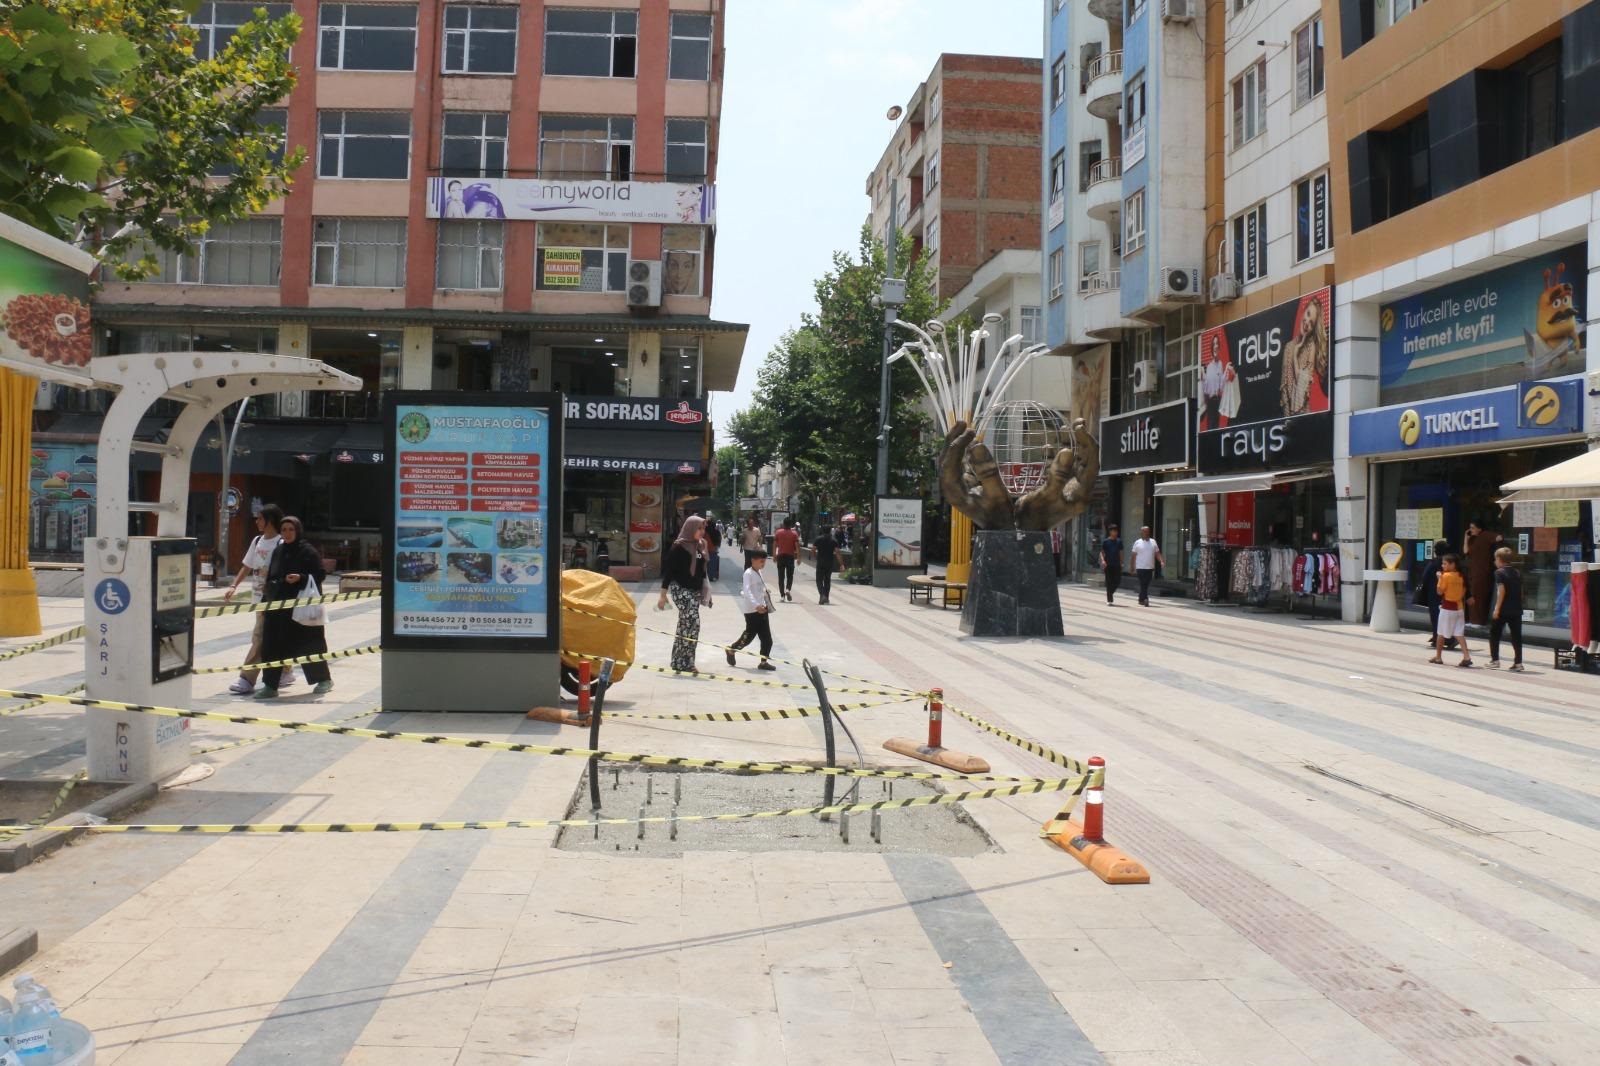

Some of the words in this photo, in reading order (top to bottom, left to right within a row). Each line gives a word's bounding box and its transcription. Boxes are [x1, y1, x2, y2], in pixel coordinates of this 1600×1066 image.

[1464, 288, 1498, 313] evde
[1238, 327, 1281, 368] rays
[1403, 327, 1452, 354] internet
[1455, 314, 1495, 343] keyfi!
[433, 416, 541, 429] MUSTAFAOĞLU
[586, 403, 660, 420] SOFRASI
[1424, 407, 1499, 434] TURKCELL
[1120, 417, 1160, 453] stilife
[1221, 424, 1286, 462] rays
[603, 460, 660, 470] SOFRASI
